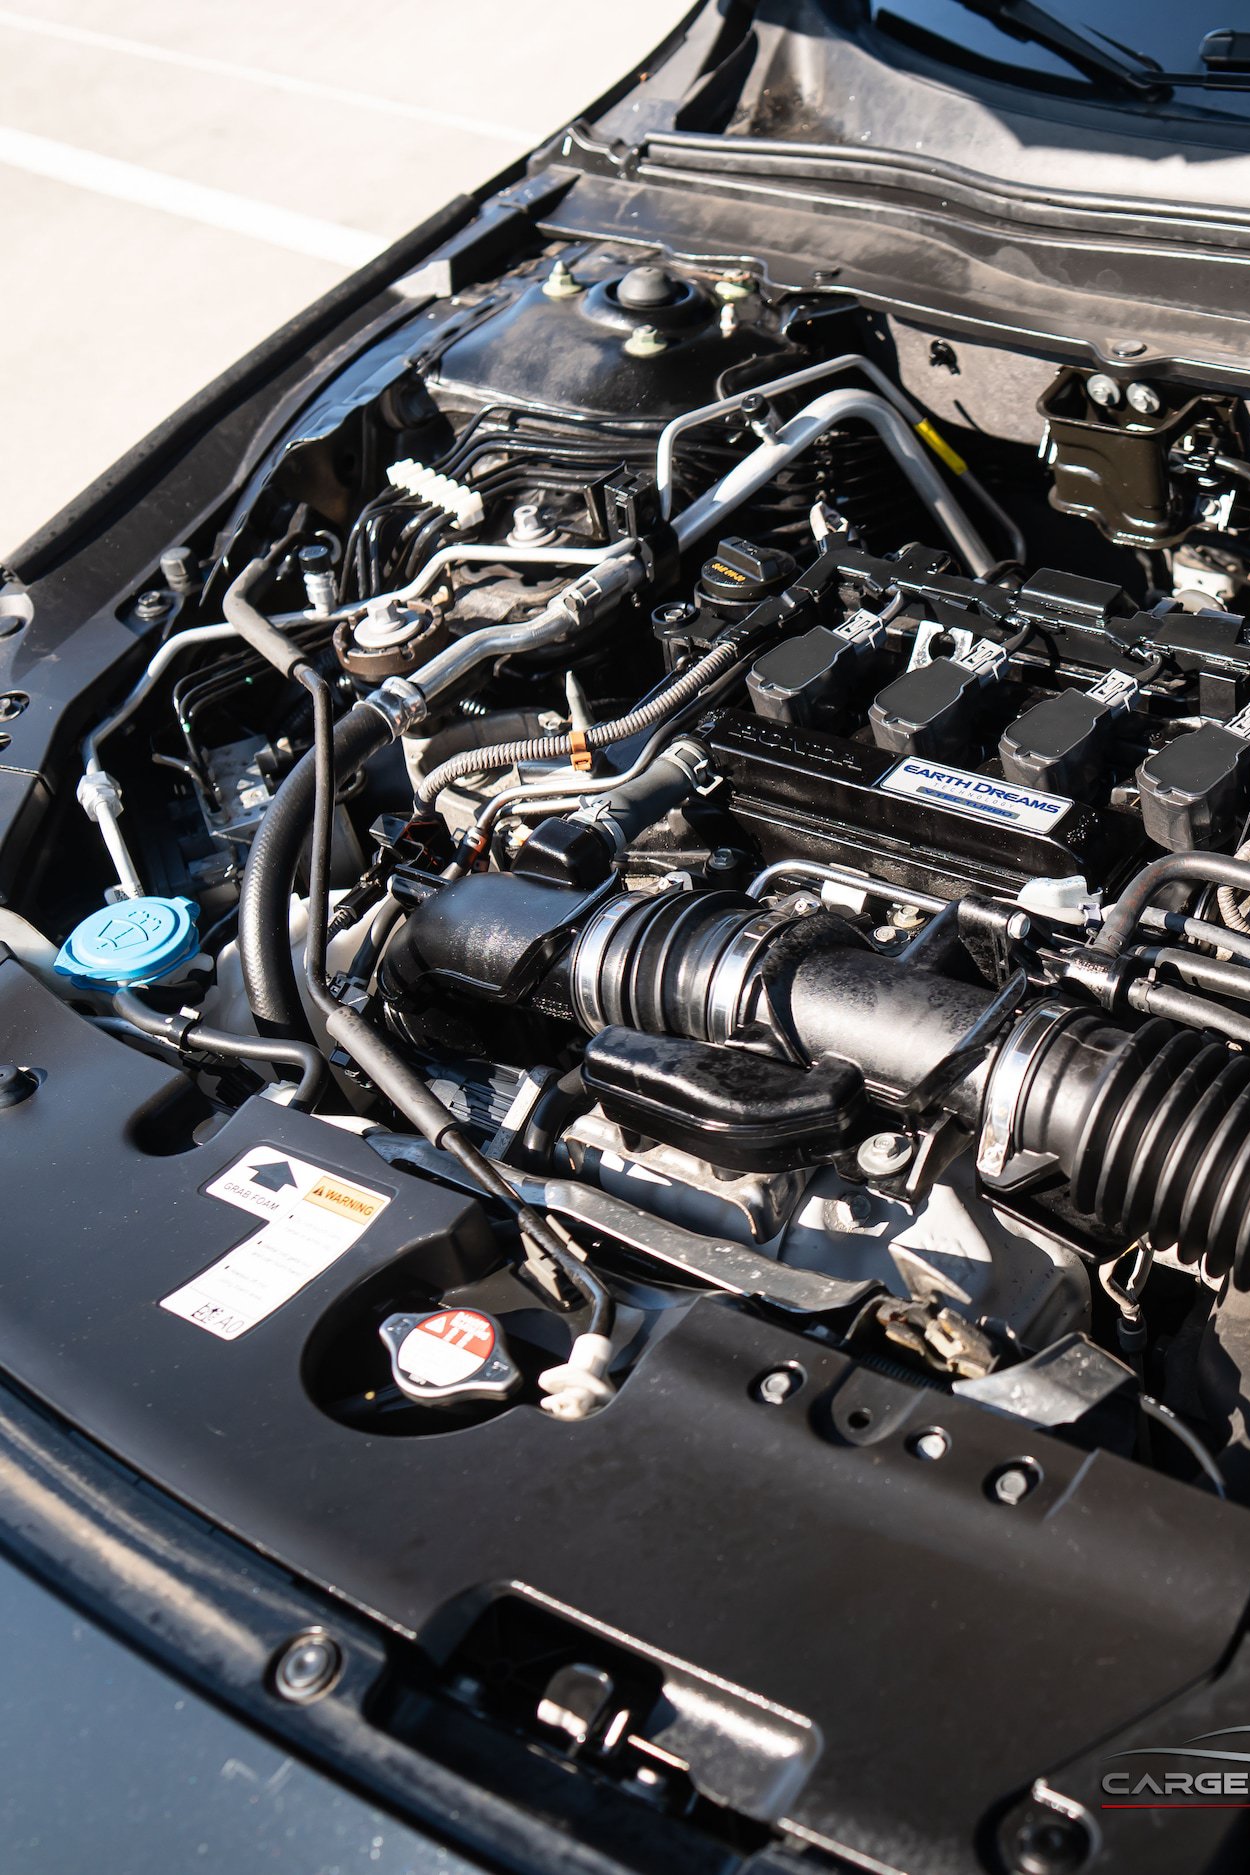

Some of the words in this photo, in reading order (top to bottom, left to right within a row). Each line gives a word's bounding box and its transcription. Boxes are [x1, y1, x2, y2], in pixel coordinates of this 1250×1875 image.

[903, 763, 972, 789] EARTH
[973, 783, 1061, 814] DREAMS
[933, 782, 1014, 809] TECHNOLOGY
[963, 799, 1013, 817] TURBO
[223, 1182, 251, 1199] GRAB
[251, 1194, 280, 1212] FOAM
[325, 1187, 375, 1217] WARNING
